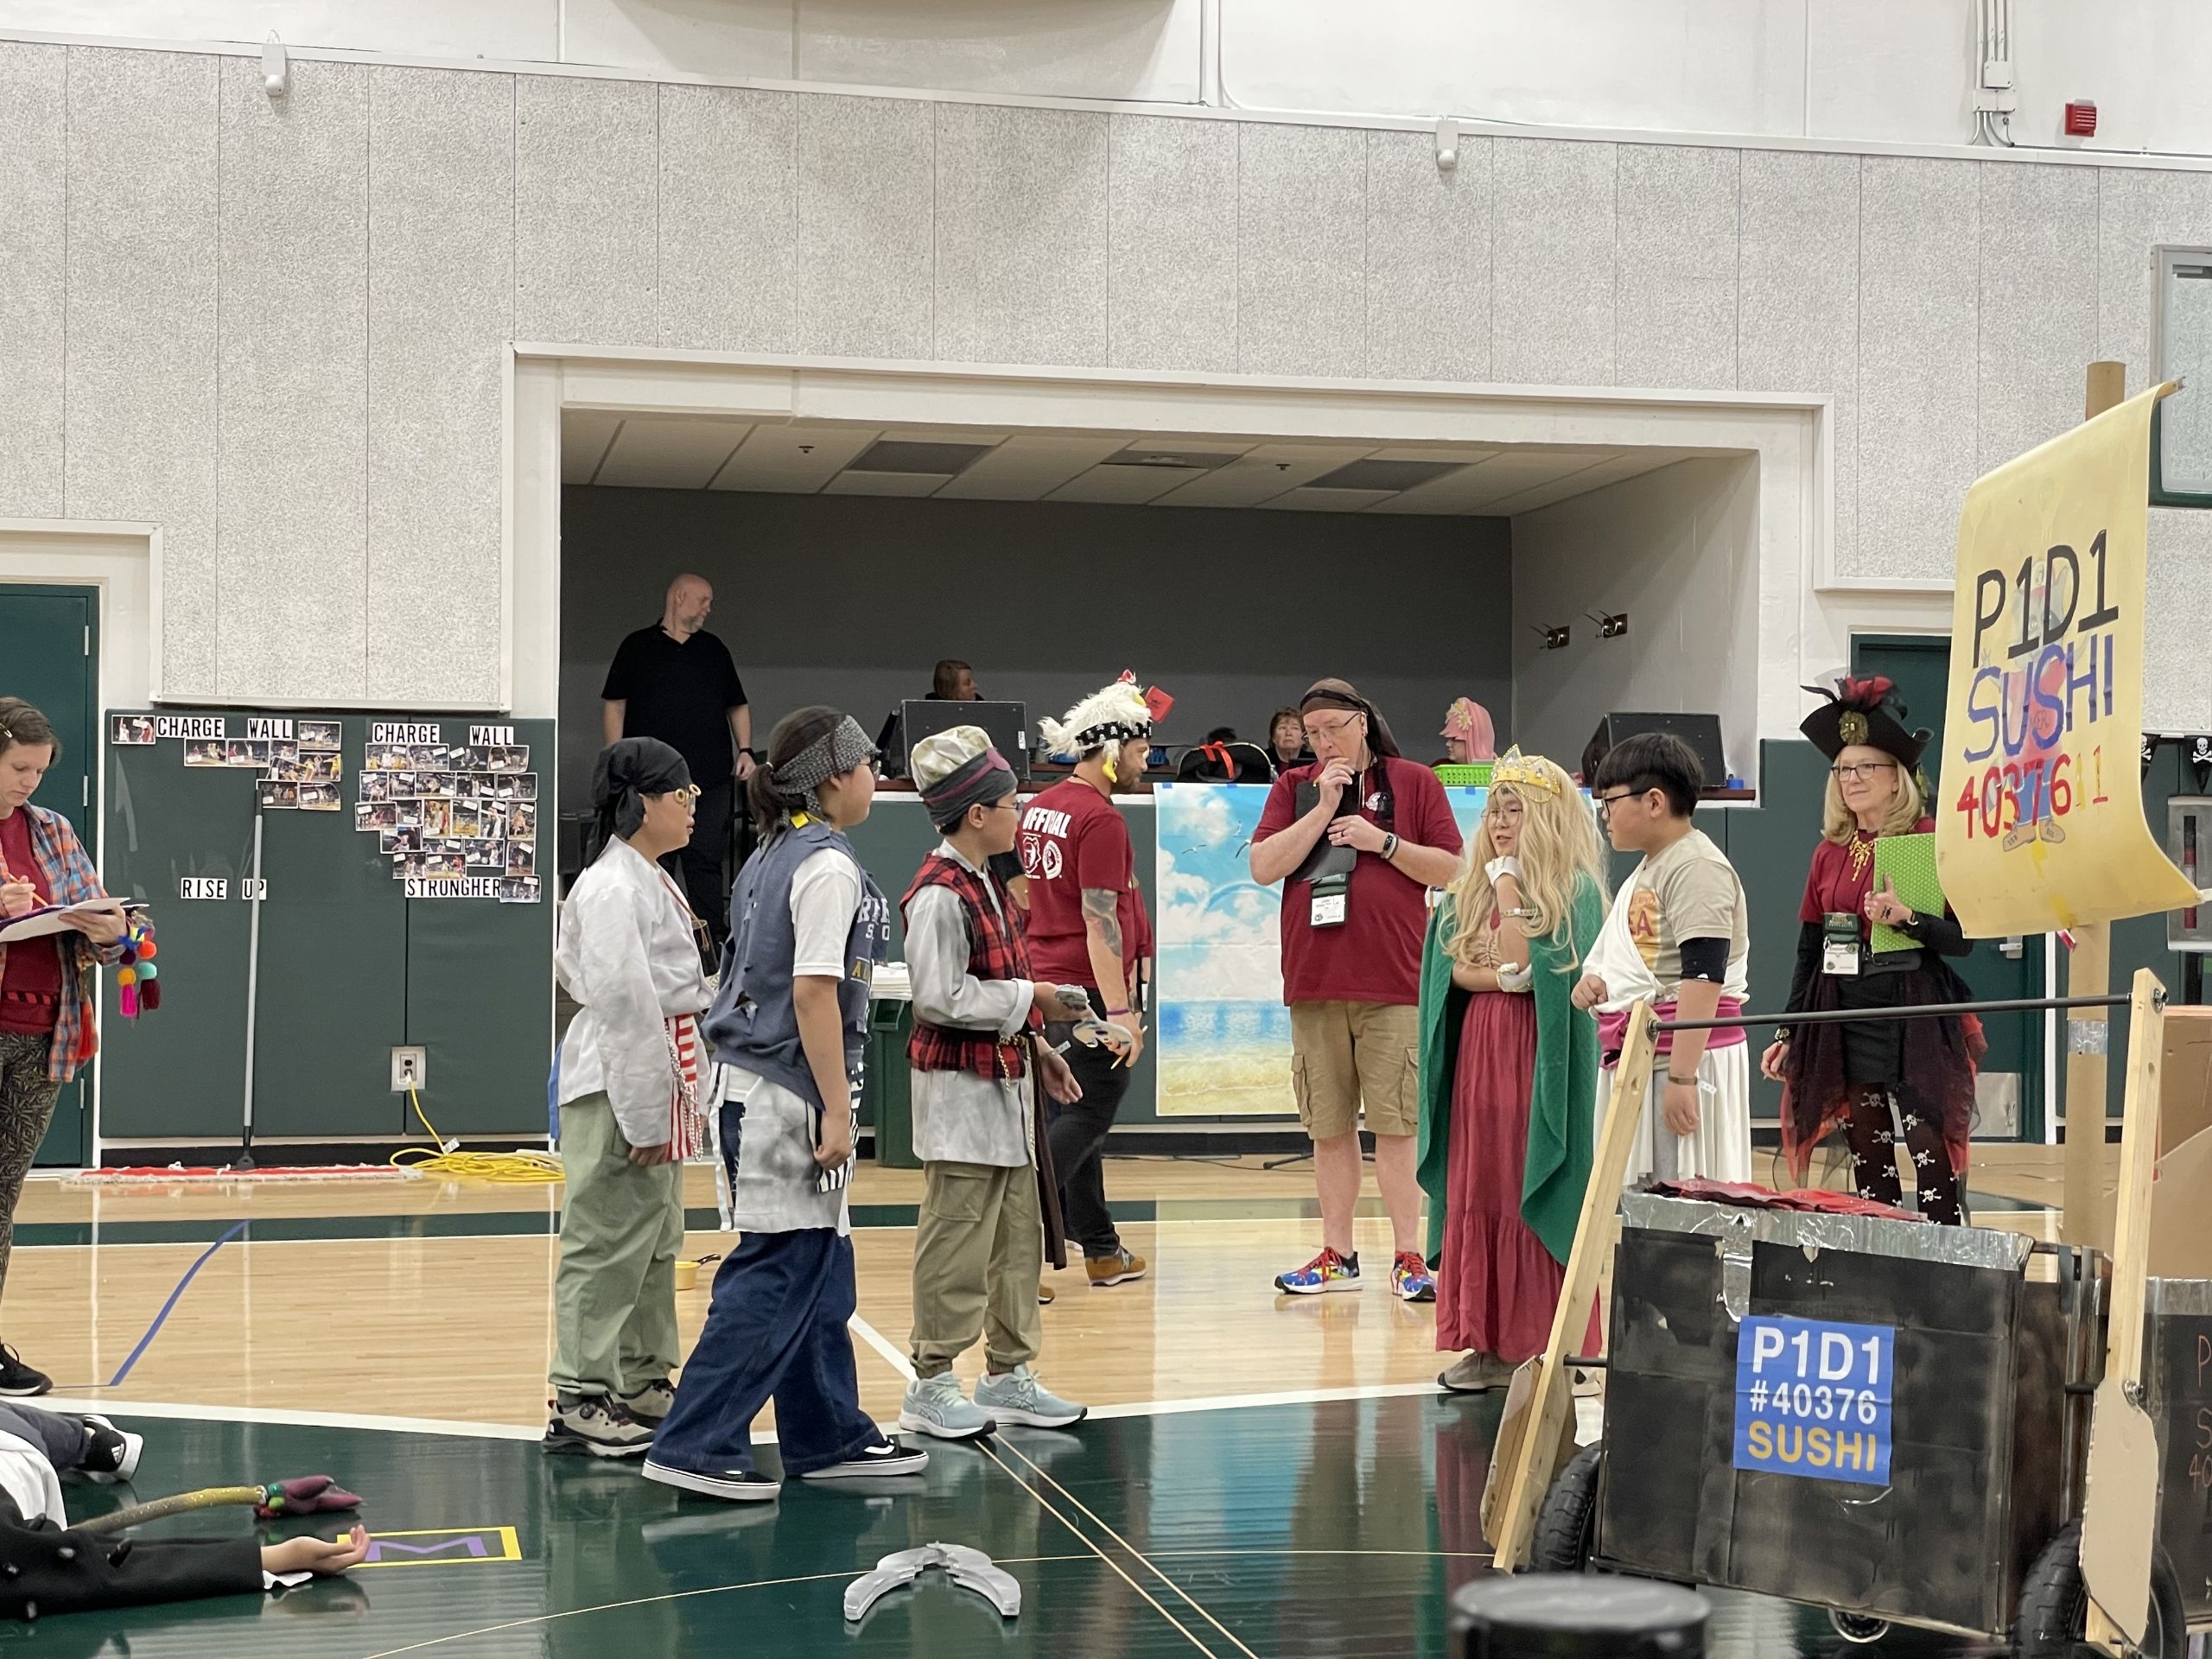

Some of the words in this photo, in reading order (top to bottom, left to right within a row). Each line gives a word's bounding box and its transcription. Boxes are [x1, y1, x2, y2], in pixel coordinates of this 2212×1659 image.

[1972, 529, 2120, 670] P1D1
[1963, 633, 2114, 764] SUSHI
[157, 717, 223, 737] CHARGE
[249, 719, 291, 739] WALL
[373, 724, 438, 743] CHARGE
[472, 726, 512, 746] WALL
[181, 879, 226, 898] RISE
[406, 878, 500, 897] STRONGHER
[1752, 1325, 1880, 1385] P1D1
[1750, 1379, 1878, 1425] #40376
[1747, 1421, 1876, 1471] SUSHI
